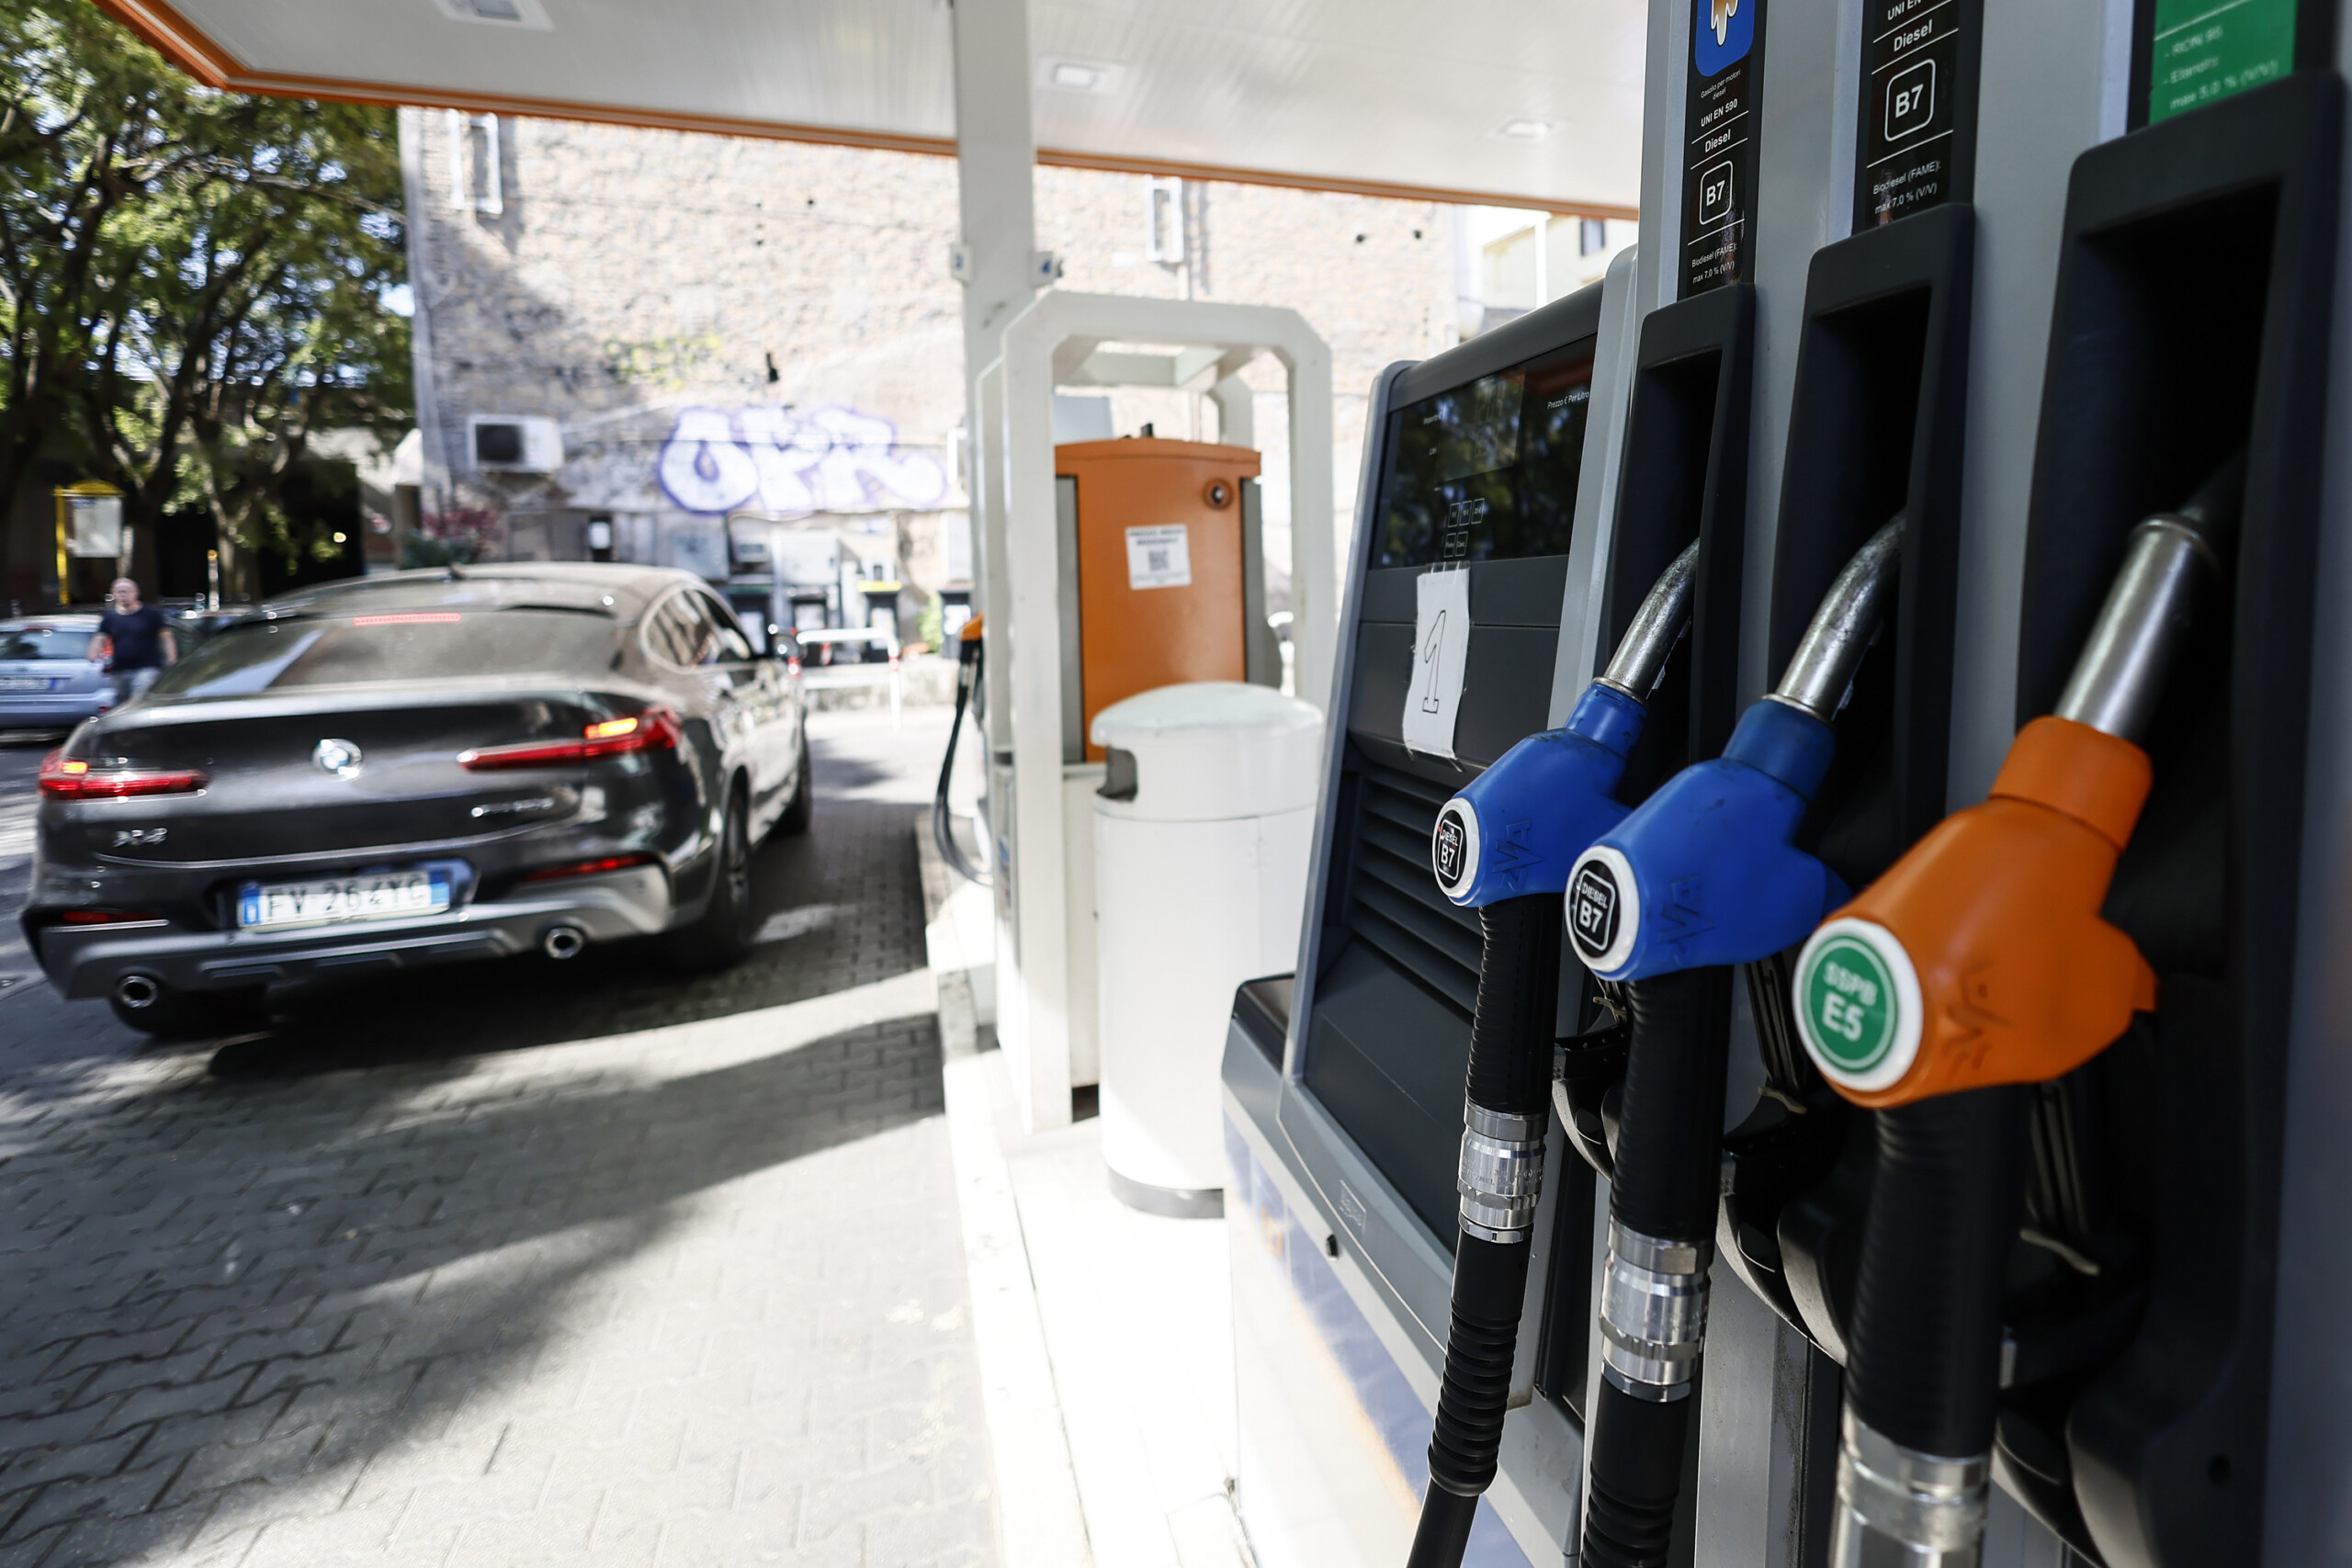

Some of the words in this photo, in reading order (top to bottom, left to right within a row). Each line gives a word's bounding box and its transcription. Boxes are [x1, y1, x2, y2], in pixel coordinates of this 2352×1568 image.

[1887, 1, 1905, 21] UNI
[1894, 18, 1933, 52] Diesel
[1700, 85, 1717, 98] Gasolio
[1712, 86, 1726, 100] diesel
[1894, 84, 1924, 119] B7
[1701, 112, 1713, 127] UNI
[1713, 106, 1724, 119] EN
[1724, 98, 1738, 113] 590
[1704, 129, 1731, 153] Diesel
[1706, 180, 1725, 207] B7
[1872, 172, 1907, 195] Biodiesel
[1874, 201, 1891, 215] max
[1891, 194, 1905, 208] 7,0
[1905, 190, 1915, 202] %
[1915, 182, 1938, 201] (V/V)
[1691, 251, 1714, 267] Biodiesel
[1692, 274, 1704, 284] max
[1713, 265, 1719, 276] %
[1547, 399, 1564, 410] Prezzo
[1567, 394, 1577, 404] Per
[1577, 390, 1589, 400] Litro
[1422, 609, 1446, 714] 1
[1442, 829, 1459, 847] DIESEL
[1441, 843, 1455, 868] B7
[268, 887, 307, 919] FV
[1580, 882, 1609, 909] DIESEL
[1579, 899, 1603, 934] B7
[1822, 990, 1865, 1042] E5
